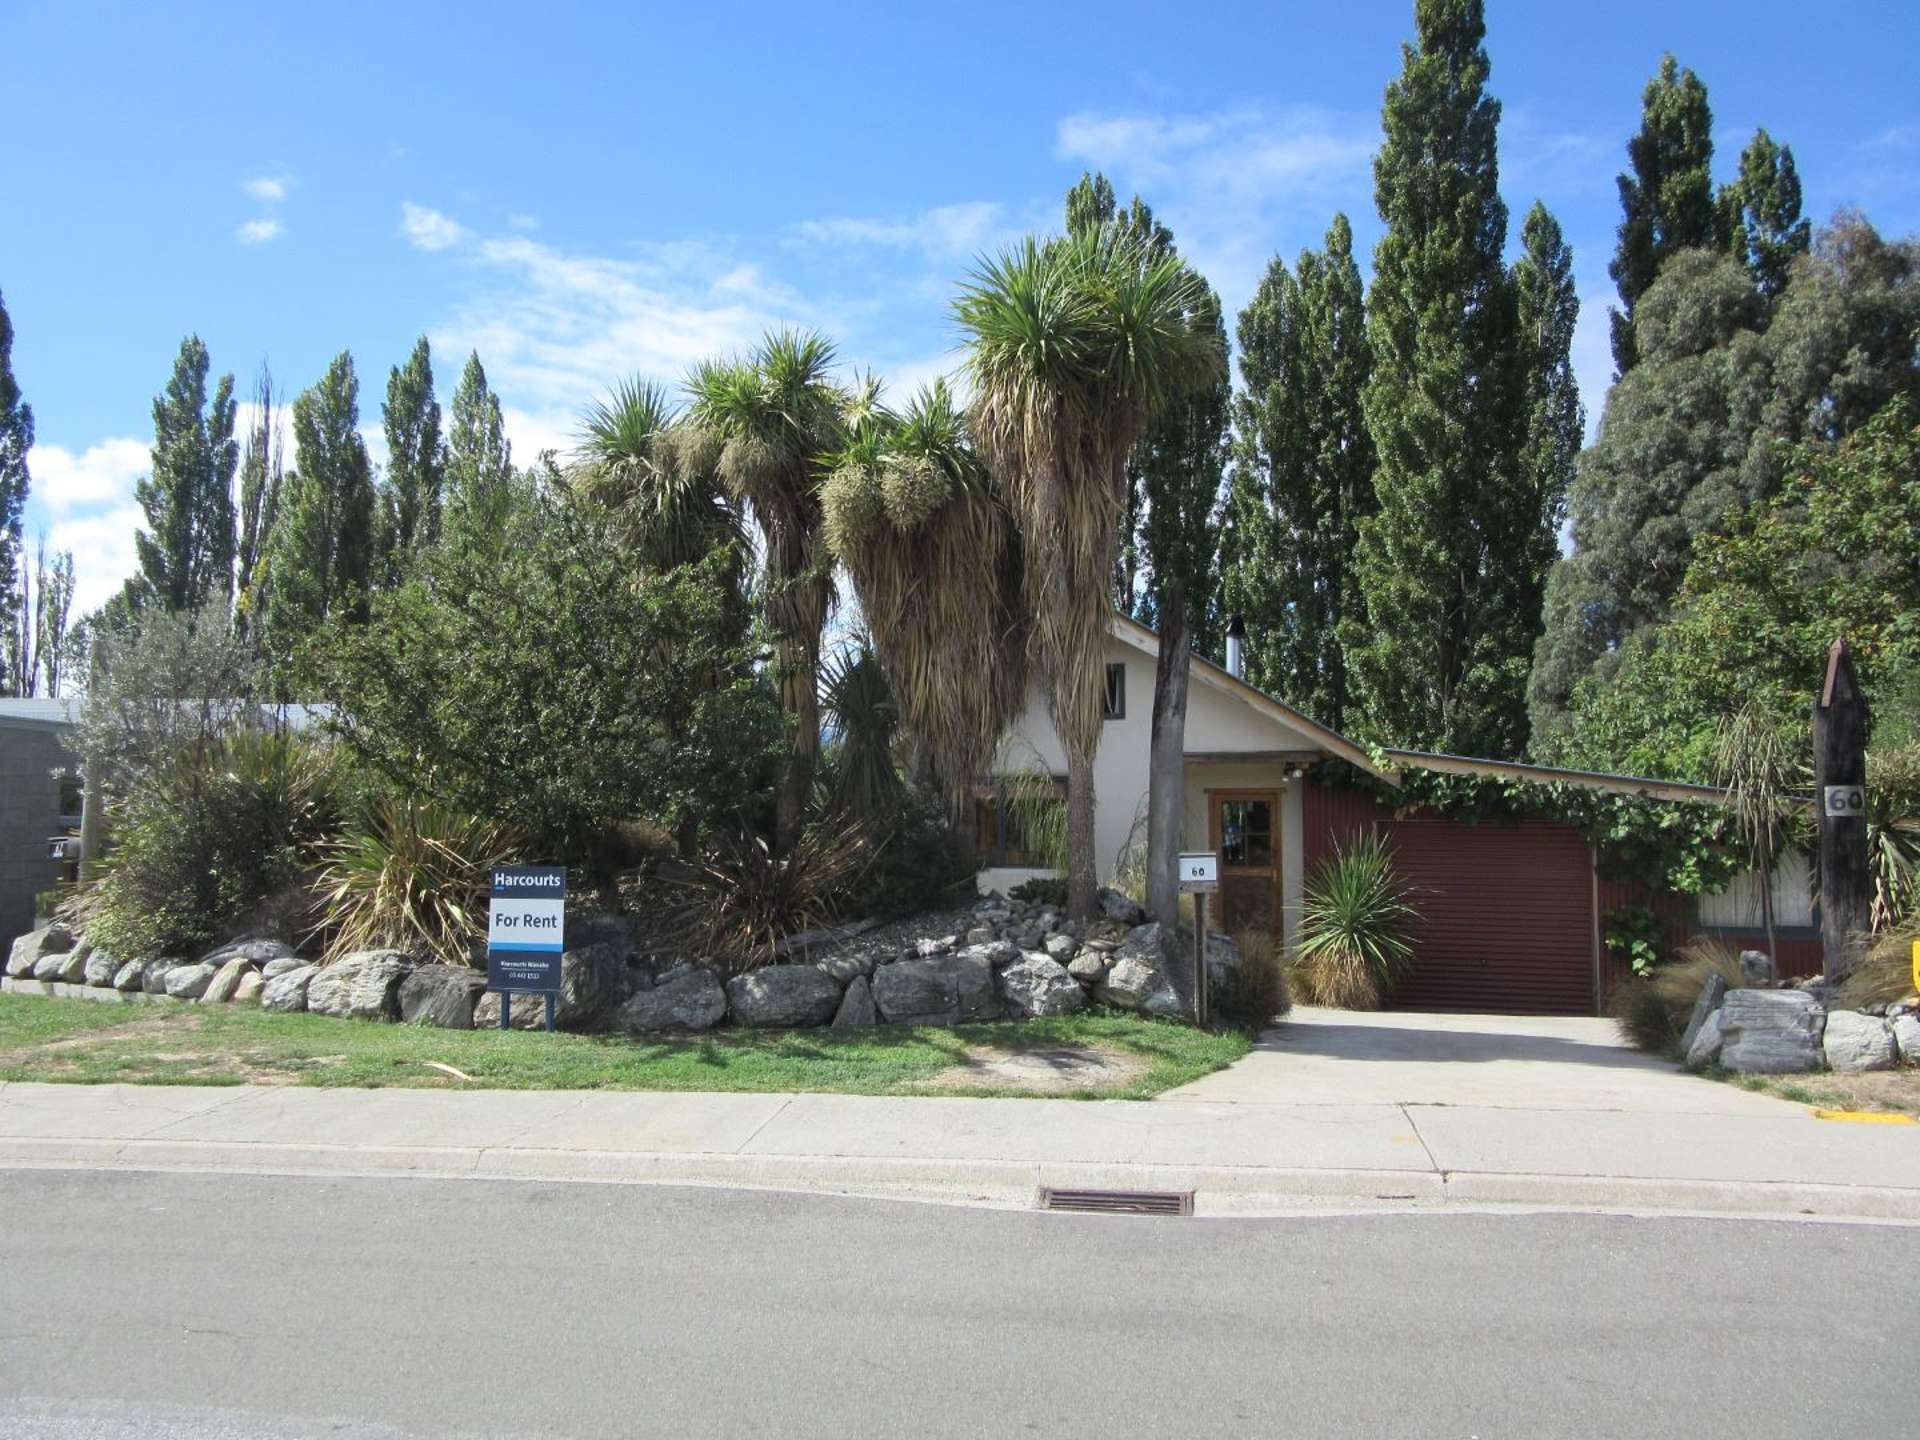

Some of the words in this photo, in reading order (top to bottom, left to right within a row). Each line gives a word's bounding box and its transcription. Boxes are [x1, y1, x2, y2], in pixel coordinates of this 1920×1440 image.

[1830, 790, 1863, 811] 60
[495, 873, 561, 886] Harcourts
[495, 913, 520, 927] For
[523, 914, 557, 928] Rent
